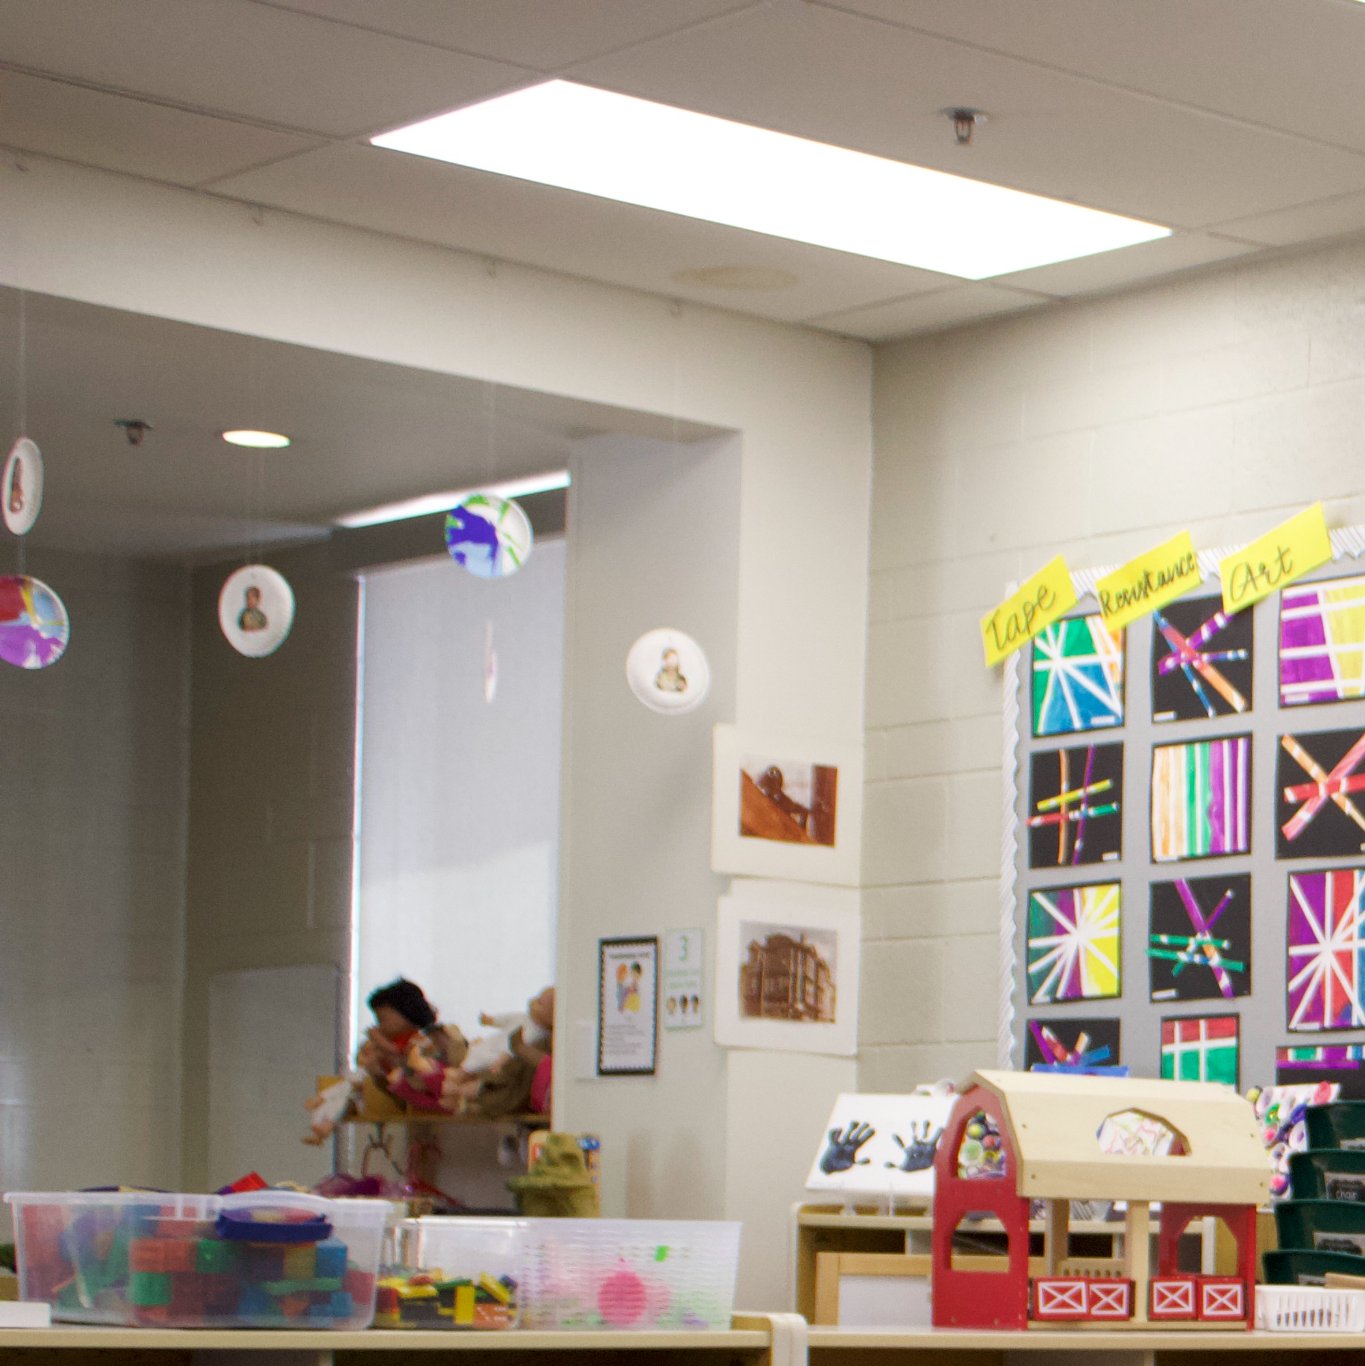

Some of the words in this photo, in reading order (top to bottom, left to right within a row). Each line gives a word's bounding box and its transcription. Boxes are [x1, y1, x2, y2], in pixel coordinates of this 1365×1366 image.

[986, 583, 1058, 652] Tape
[1100, 551, 1197, 618] Resistance
[1230, 545, 1293, 603] Art
